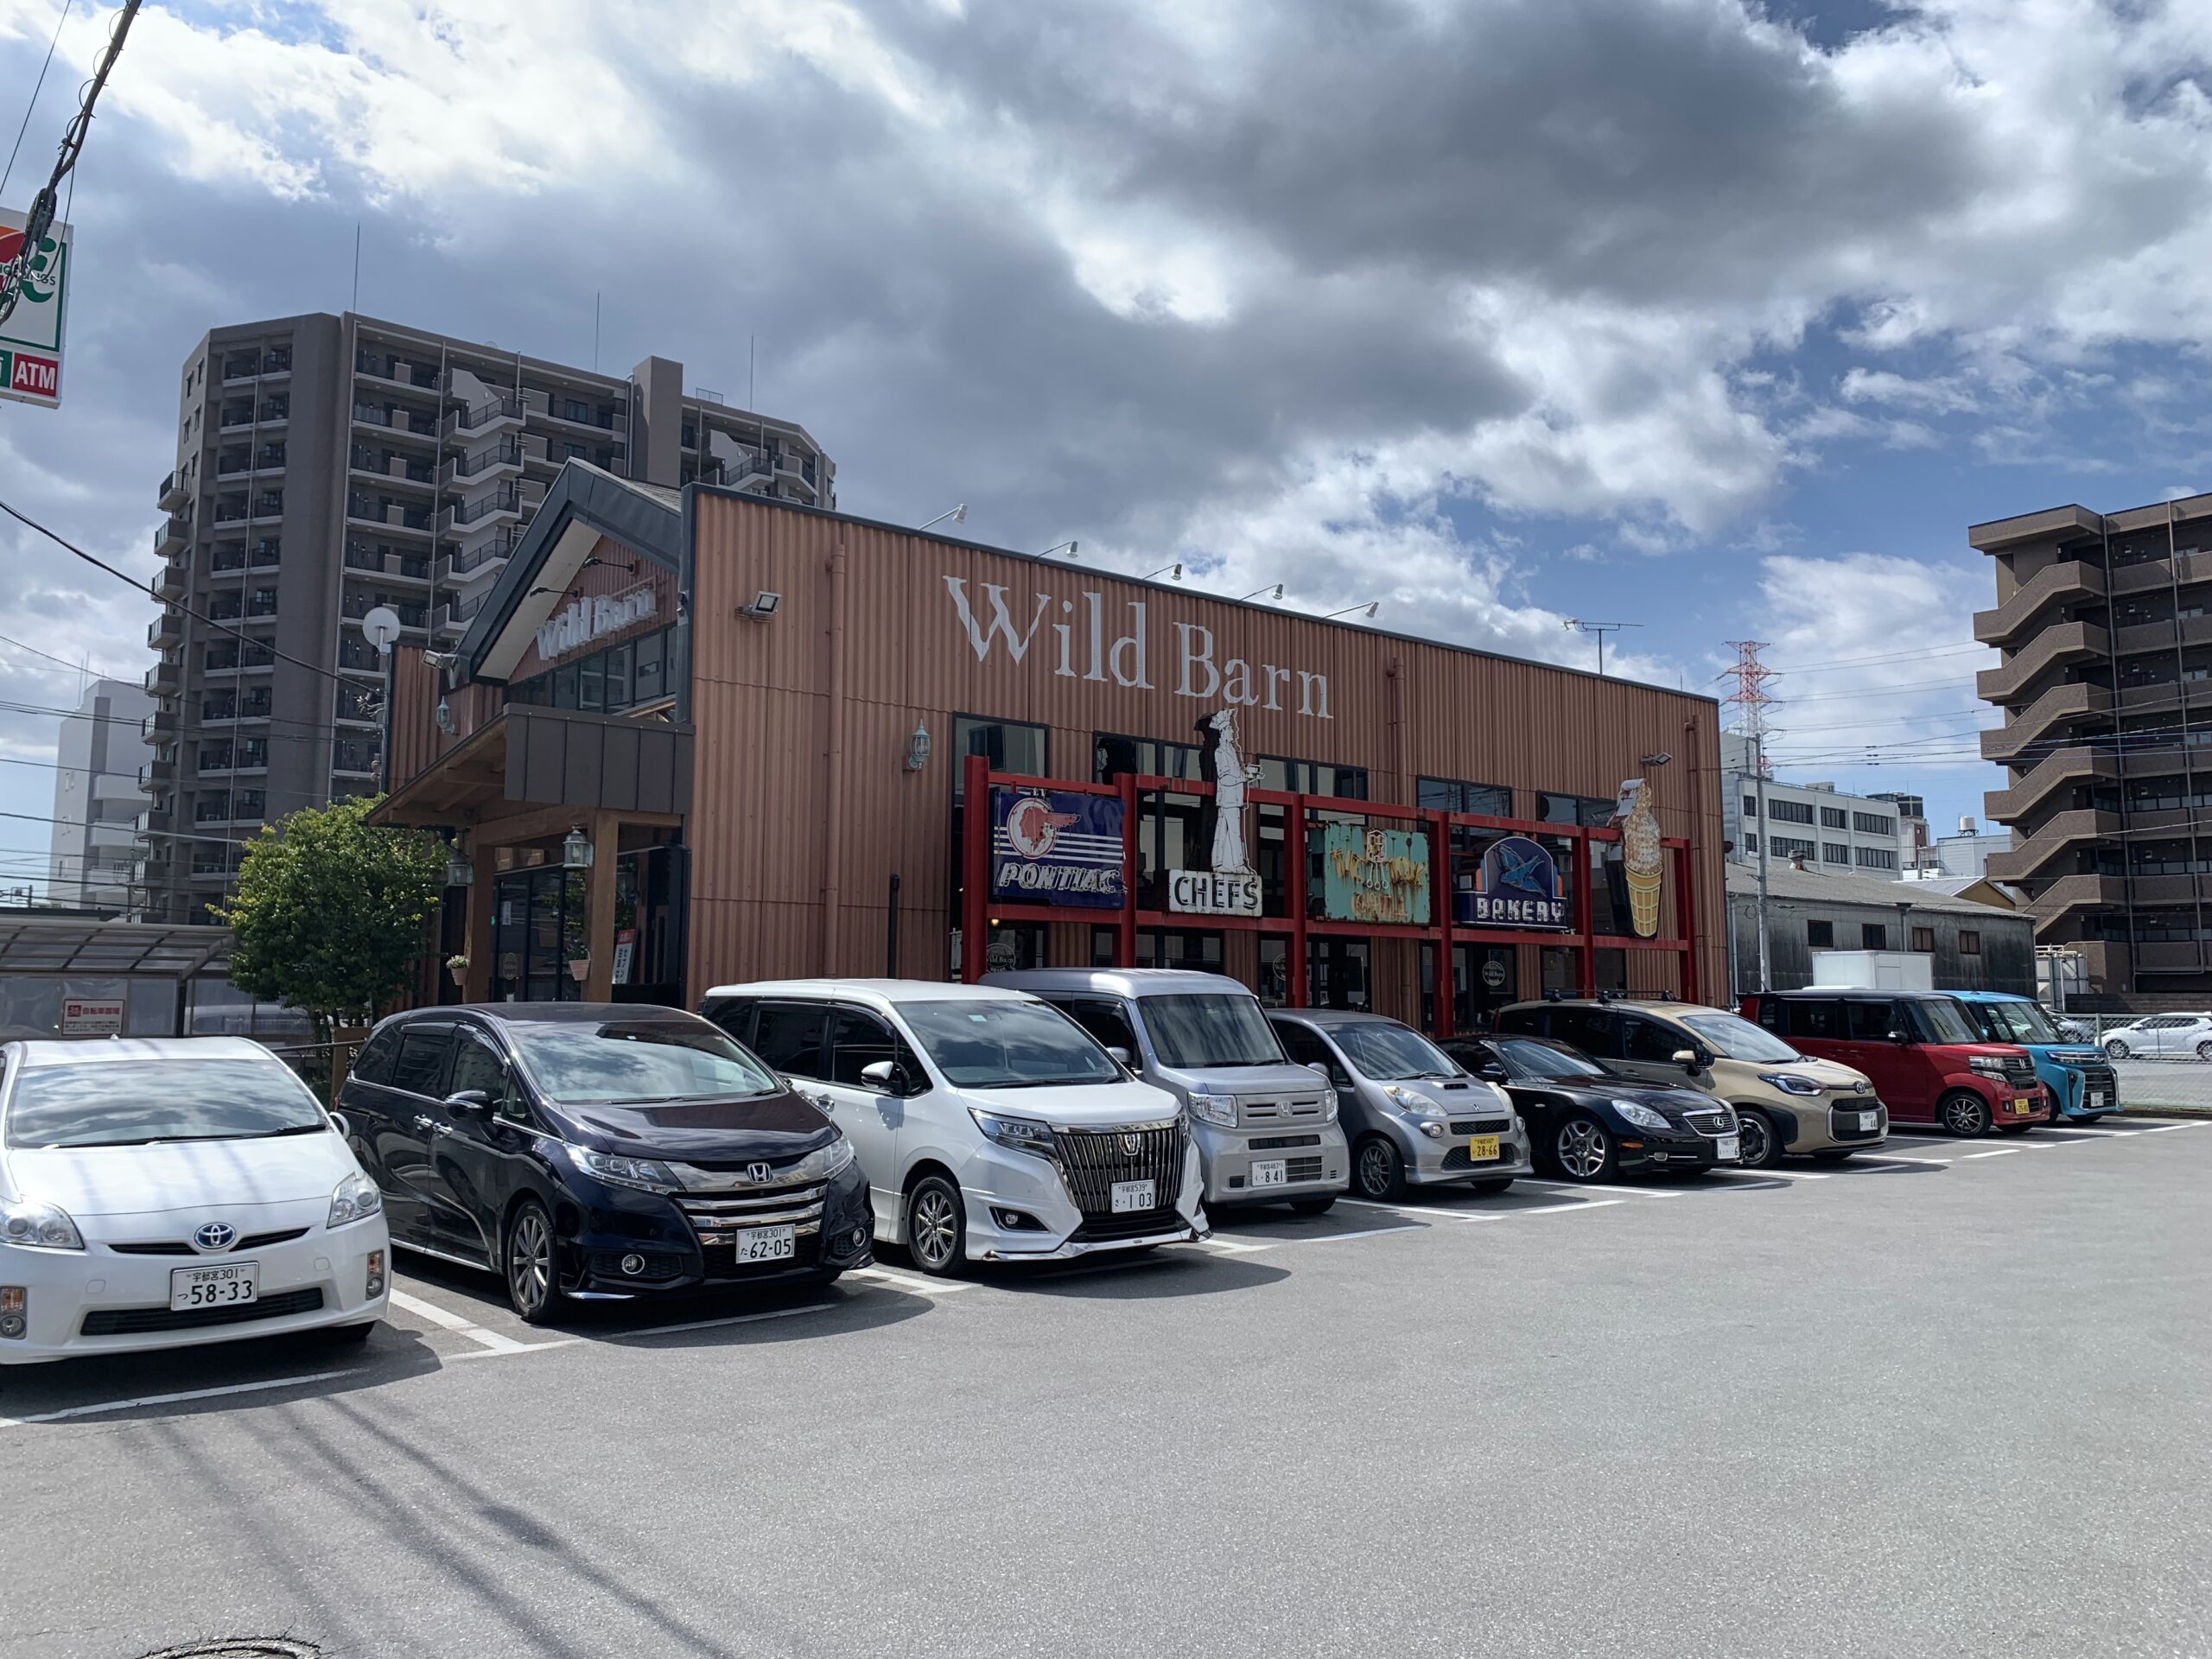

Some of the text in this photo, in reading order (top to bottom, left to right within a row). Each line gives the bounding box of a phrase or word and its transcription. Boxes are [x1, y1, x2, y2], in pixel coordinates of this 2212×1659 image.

[15, 360, 55, 390] ATM
[943, 575, 1334, 719] Wild Barn
[998, 862, 1121, 893] PONTIAC
[1174, 875, 1259, 910] CHEFS
[1477, 897, 1565, 922] BAKERY
[1478, 1145, 1497, 1156] 28-66
[751, 1228, 782, 1240] 宇都宮301
[750, 1238, 791, 1259] 62-05
[192, 1268, 238, 1282] 宇都宮301
[191, 1280, 252, 1305] 58-33
